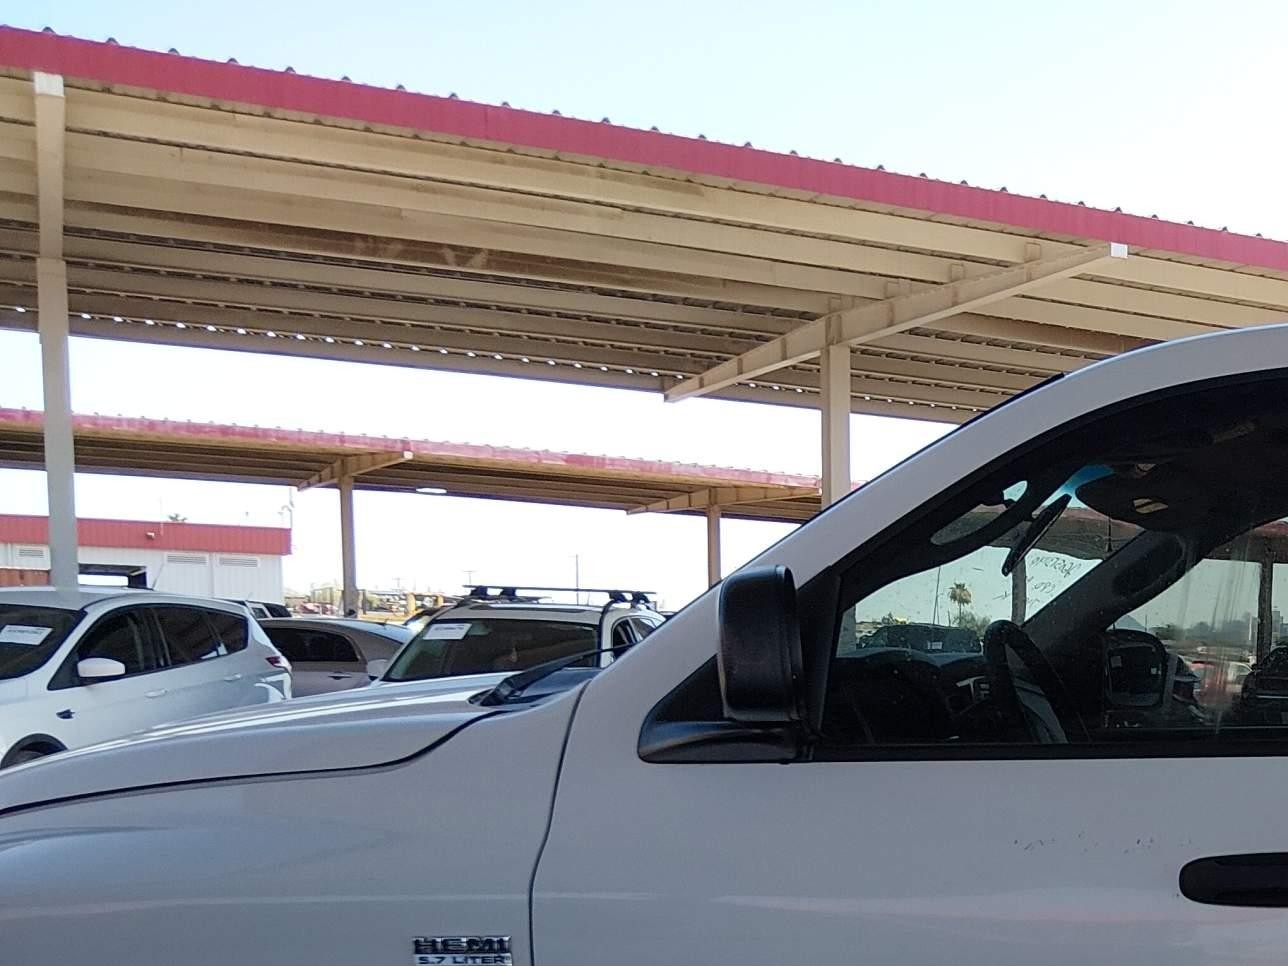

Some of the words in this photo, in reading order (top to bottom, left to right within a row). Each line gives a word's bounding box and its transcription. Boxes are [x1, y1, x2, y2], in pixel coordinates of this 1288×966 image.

[413, 936, 511, 954] HEMI
[418, 955, 446, 965] 5.7
[452, 955, 505, 965] LITER
